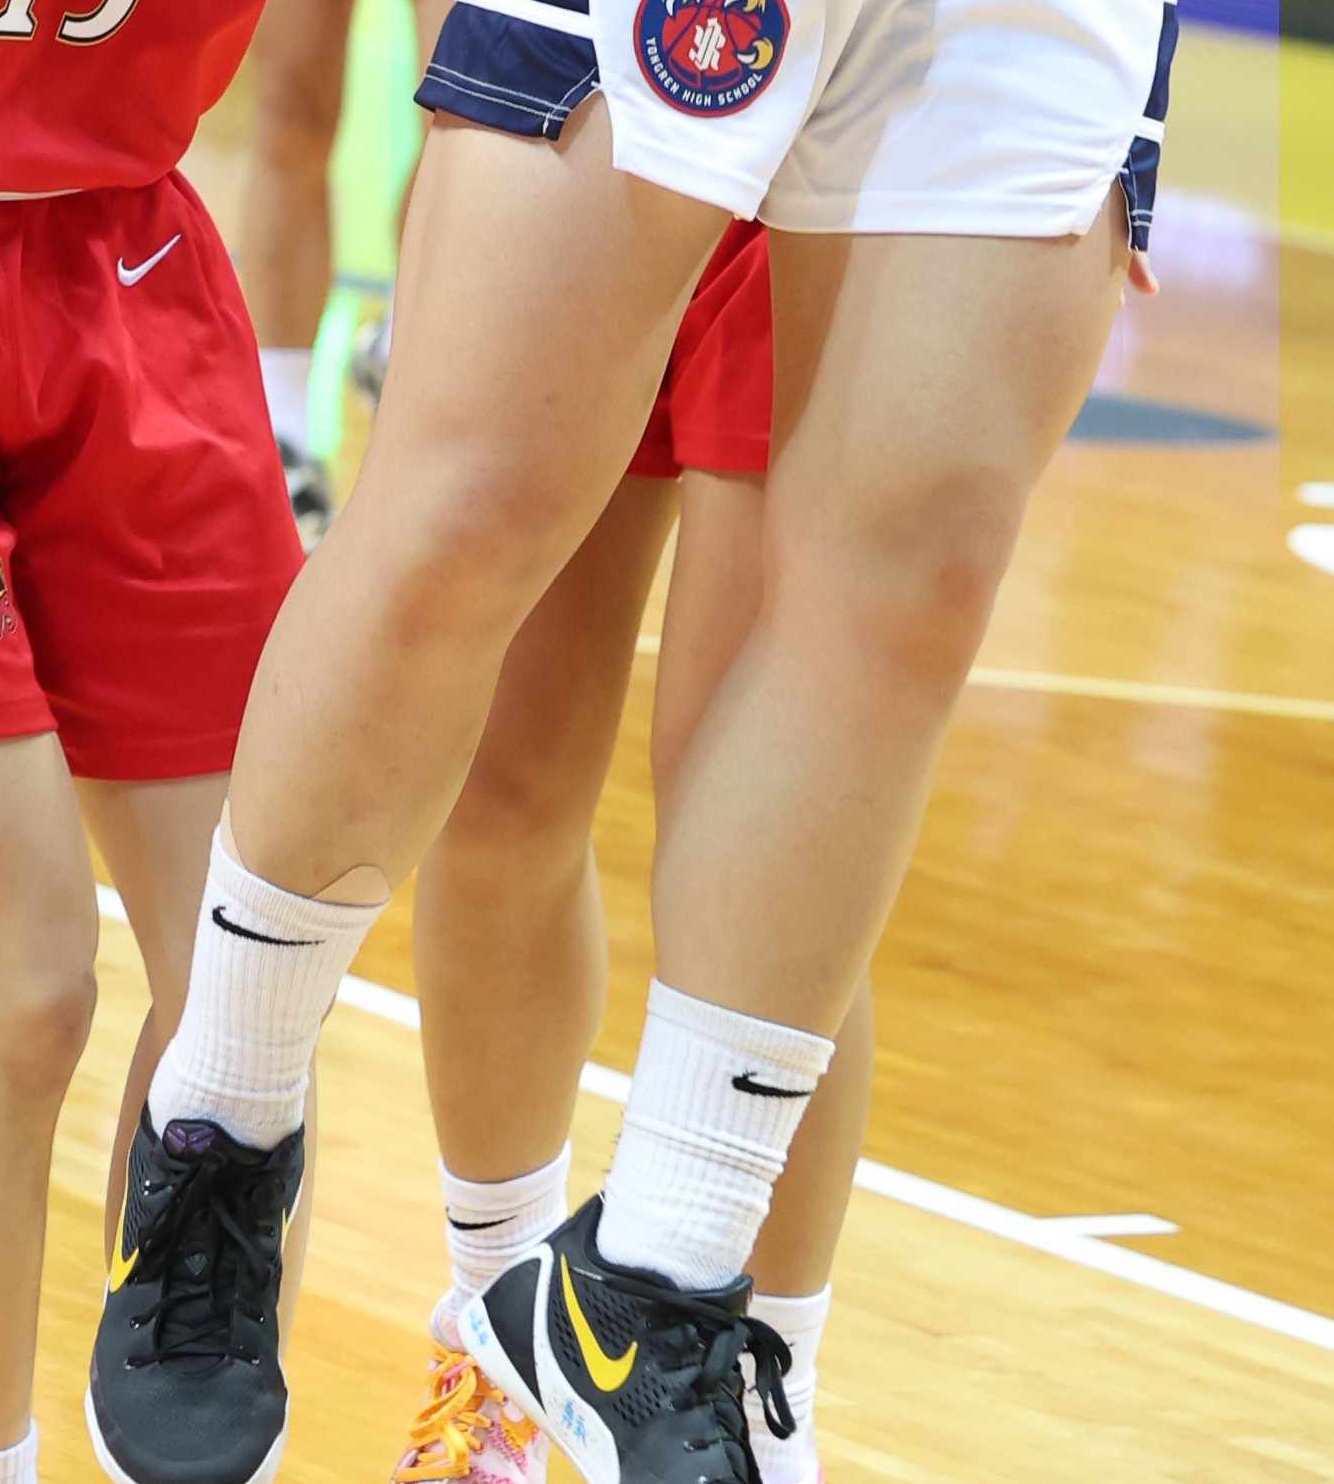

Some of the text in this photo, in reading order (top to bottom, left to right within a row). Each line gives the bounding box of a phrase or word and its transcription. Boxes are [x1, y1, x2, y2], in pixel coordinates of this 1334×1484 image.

[646, 37, 764, 107] YONGREN HIGH SCHOOL
